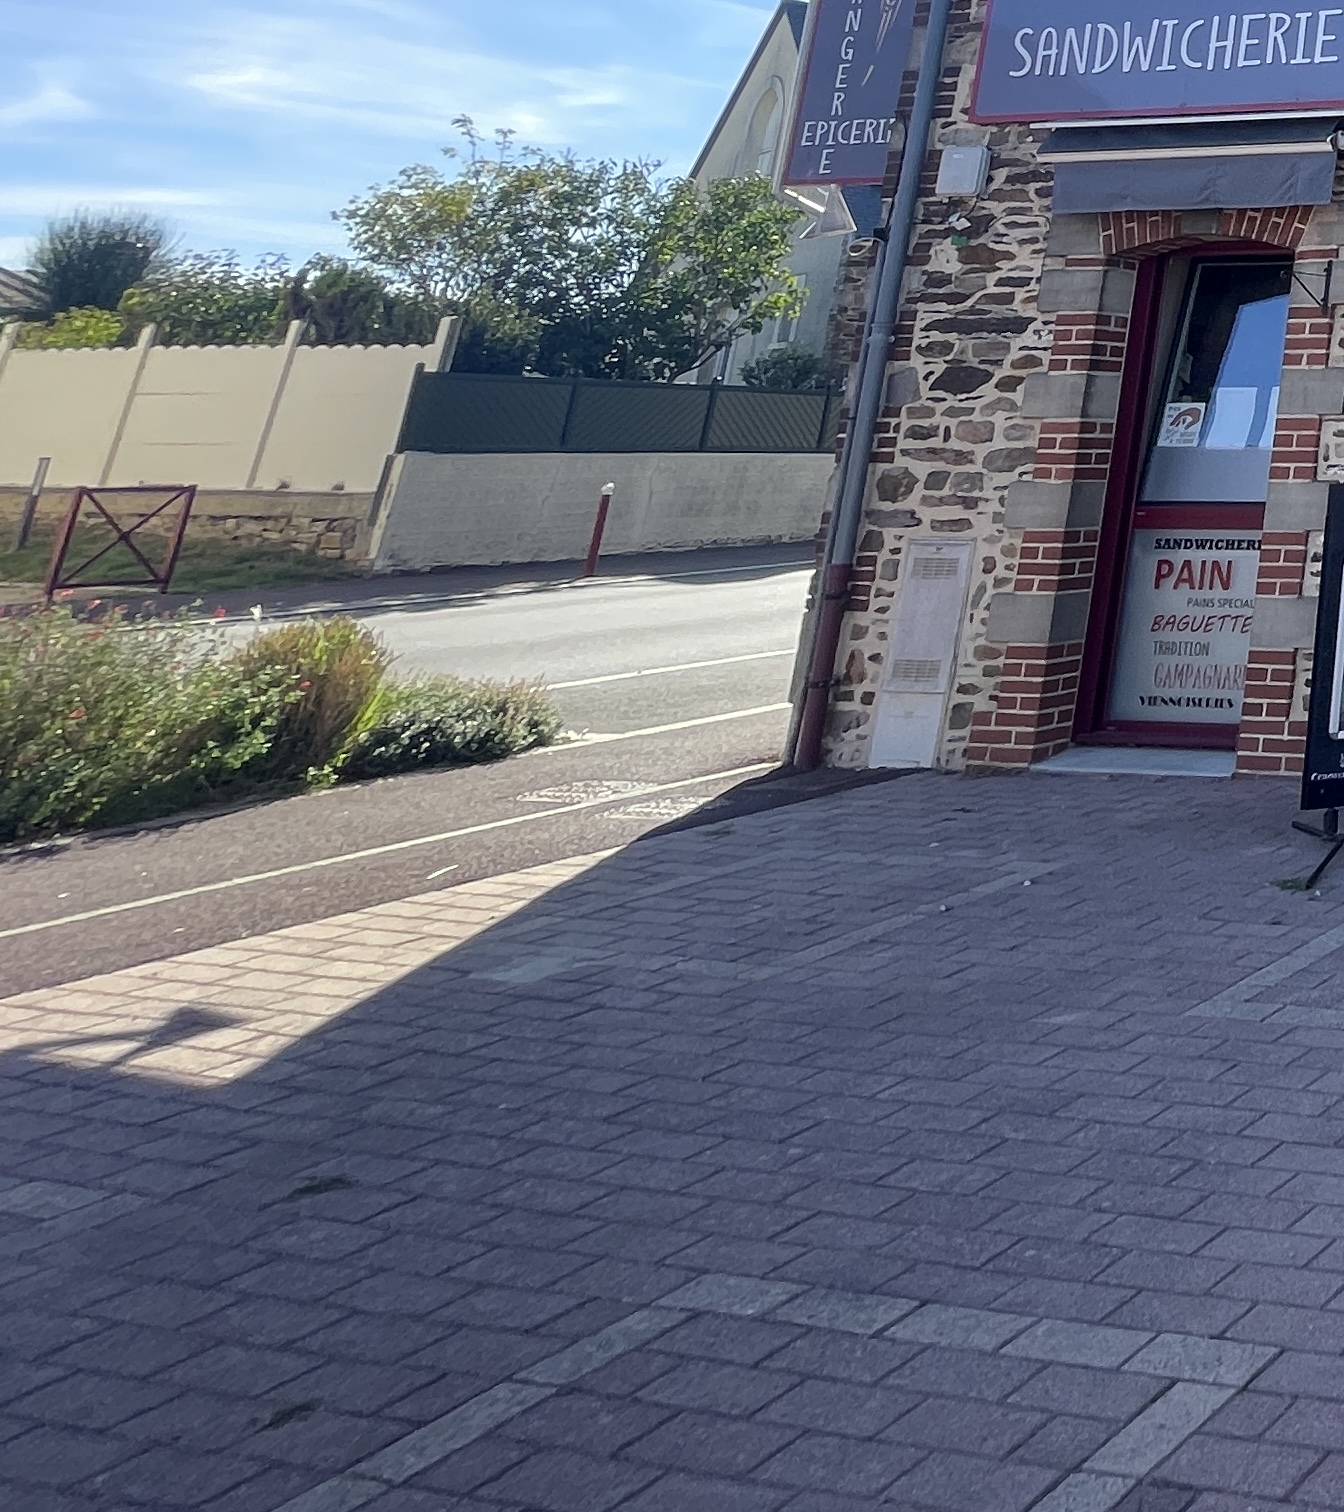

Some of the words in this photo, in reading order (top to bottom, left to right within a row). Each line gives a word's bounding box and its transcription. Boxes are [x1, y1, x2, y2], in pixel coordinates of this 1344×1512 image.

[1009, 9, 1343, 77] SANDWICHERIE
[1153, 559, 1233, 591] PAIN
[1186, 598, 1215, 608] PAINS
[1150, 614, 1254, 634] BAGUETTE
[1153, 640, 1211, 657] TRADITION
